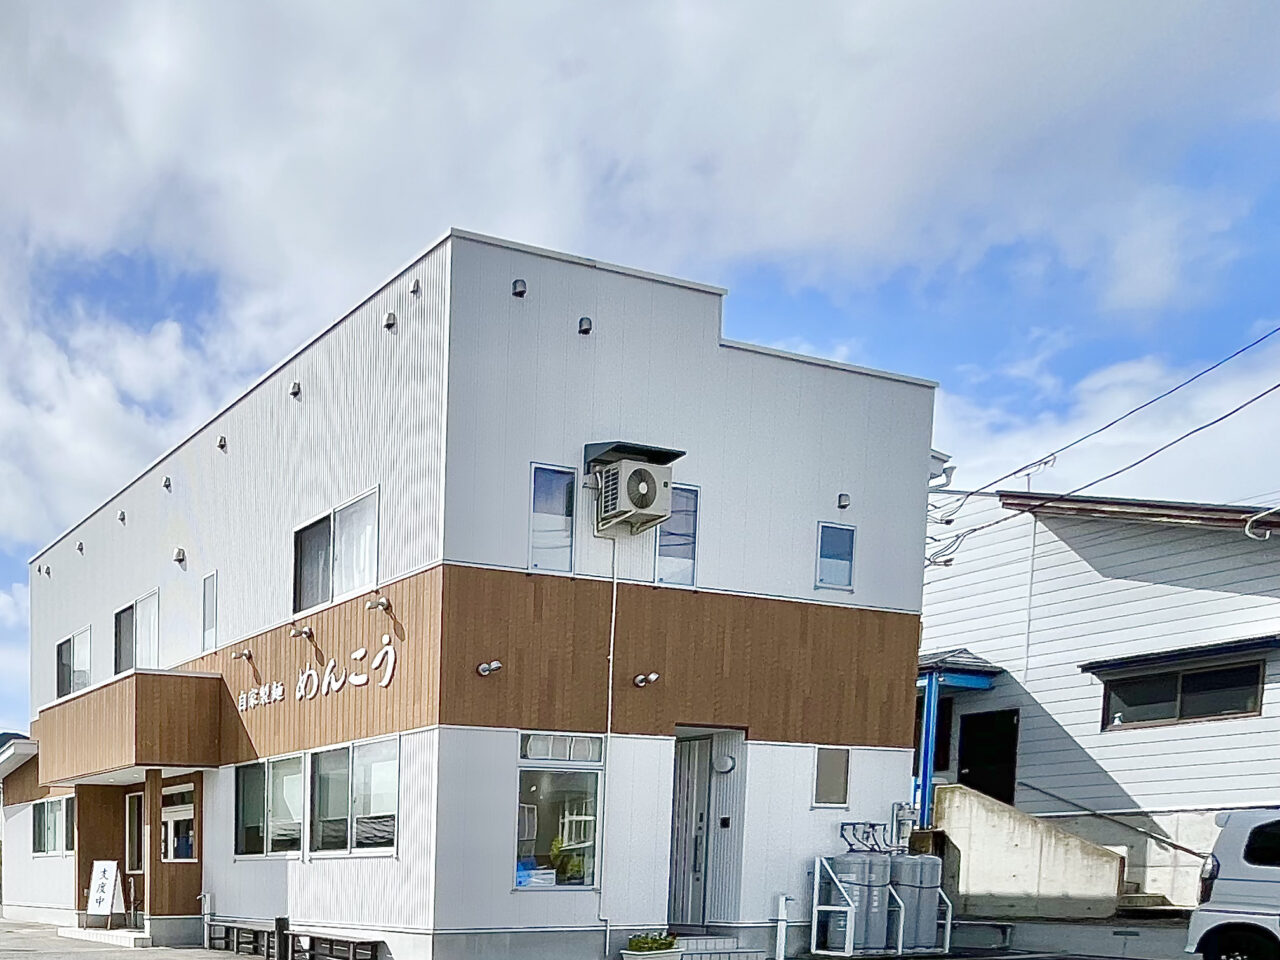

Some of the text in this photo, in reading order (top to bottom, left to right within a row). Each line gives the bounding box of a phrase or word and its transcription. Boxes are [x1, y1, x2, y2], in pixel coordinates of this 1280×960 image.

[296, 634, 397, 700] めんこう
[95, 867, 109, 908] 支度中
